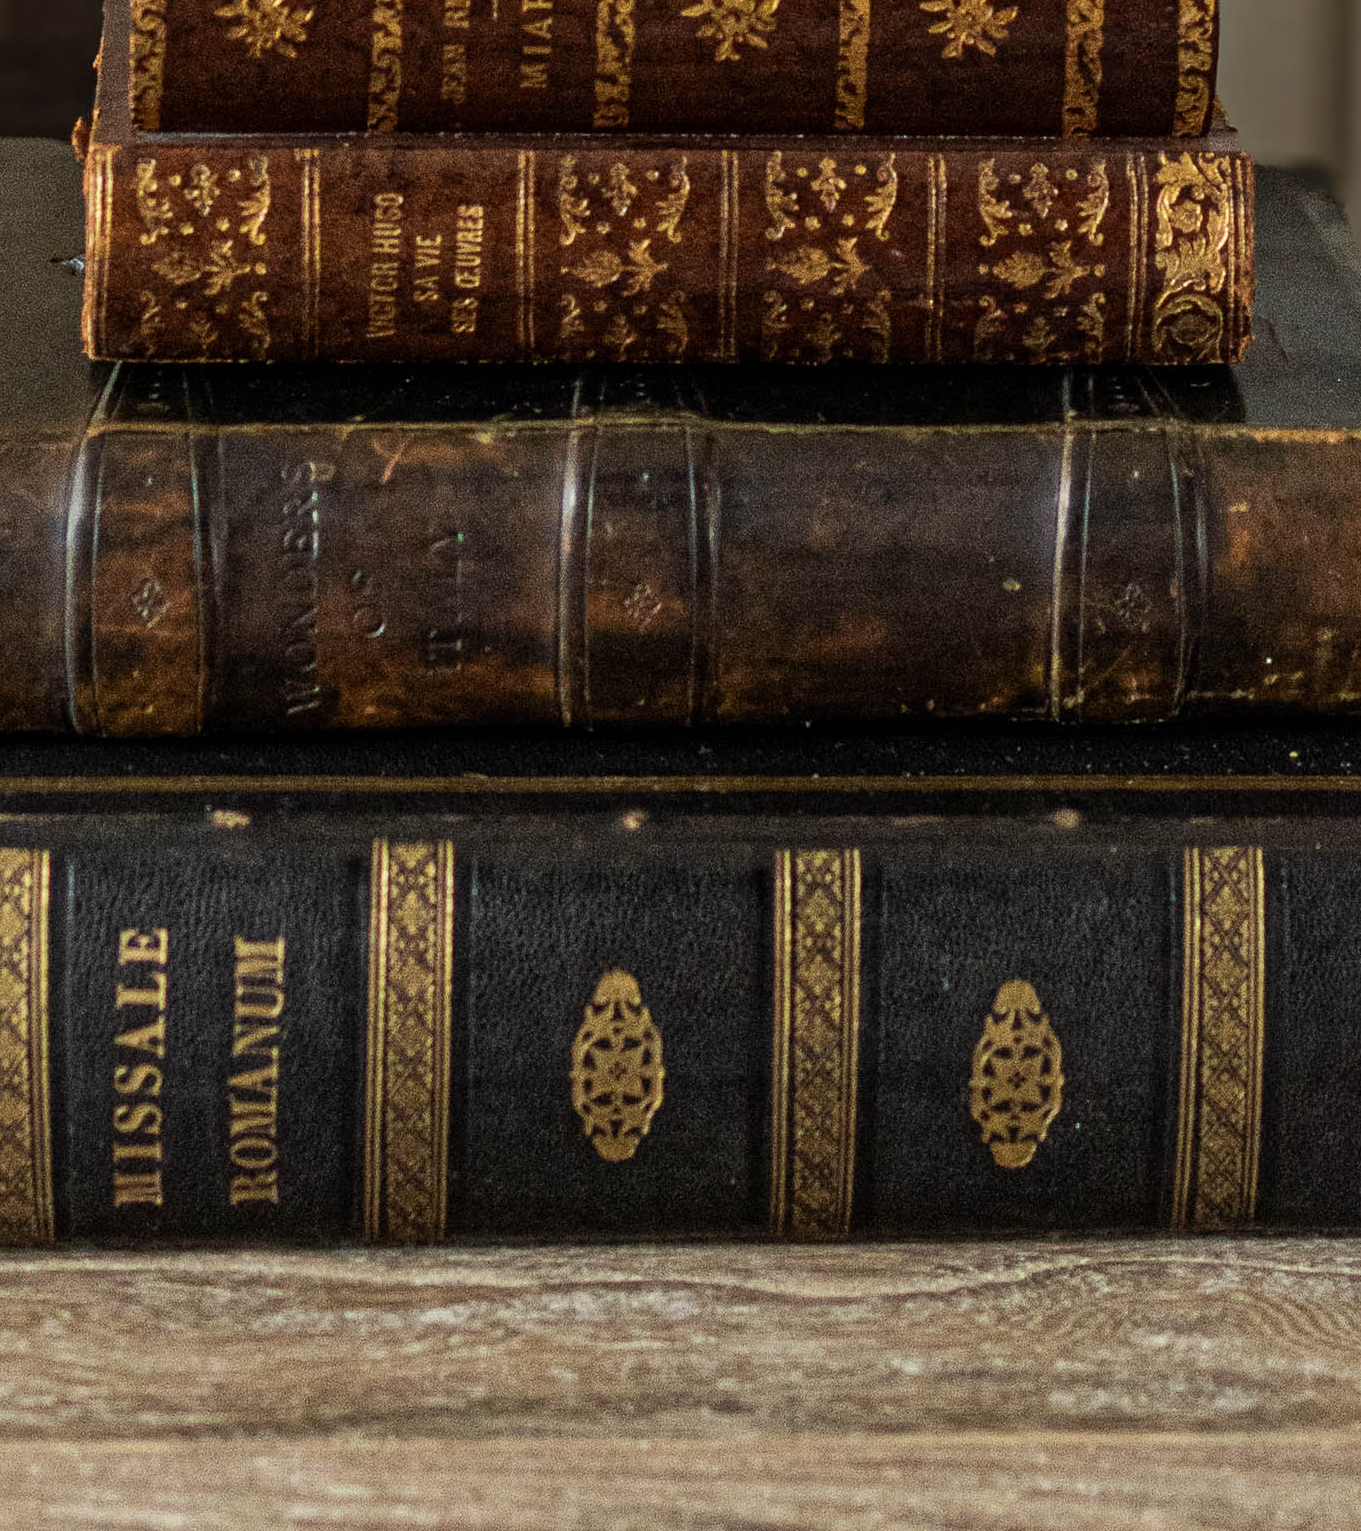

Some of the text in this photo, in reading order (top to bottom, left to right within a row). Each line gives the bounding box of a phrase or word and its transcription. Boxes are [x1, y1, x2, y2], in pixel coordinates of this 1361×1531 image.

[367, 193, 404, 338] VICTOR HUGO
[414, 235, 442, 303] SA VIE
[451, 297, 478, 333] SES
[281, 461, 321, 716] WONDERS
[112, 928, 169, 1208] MISSALE
[227, 936, 286, 1205] ROMANUM
